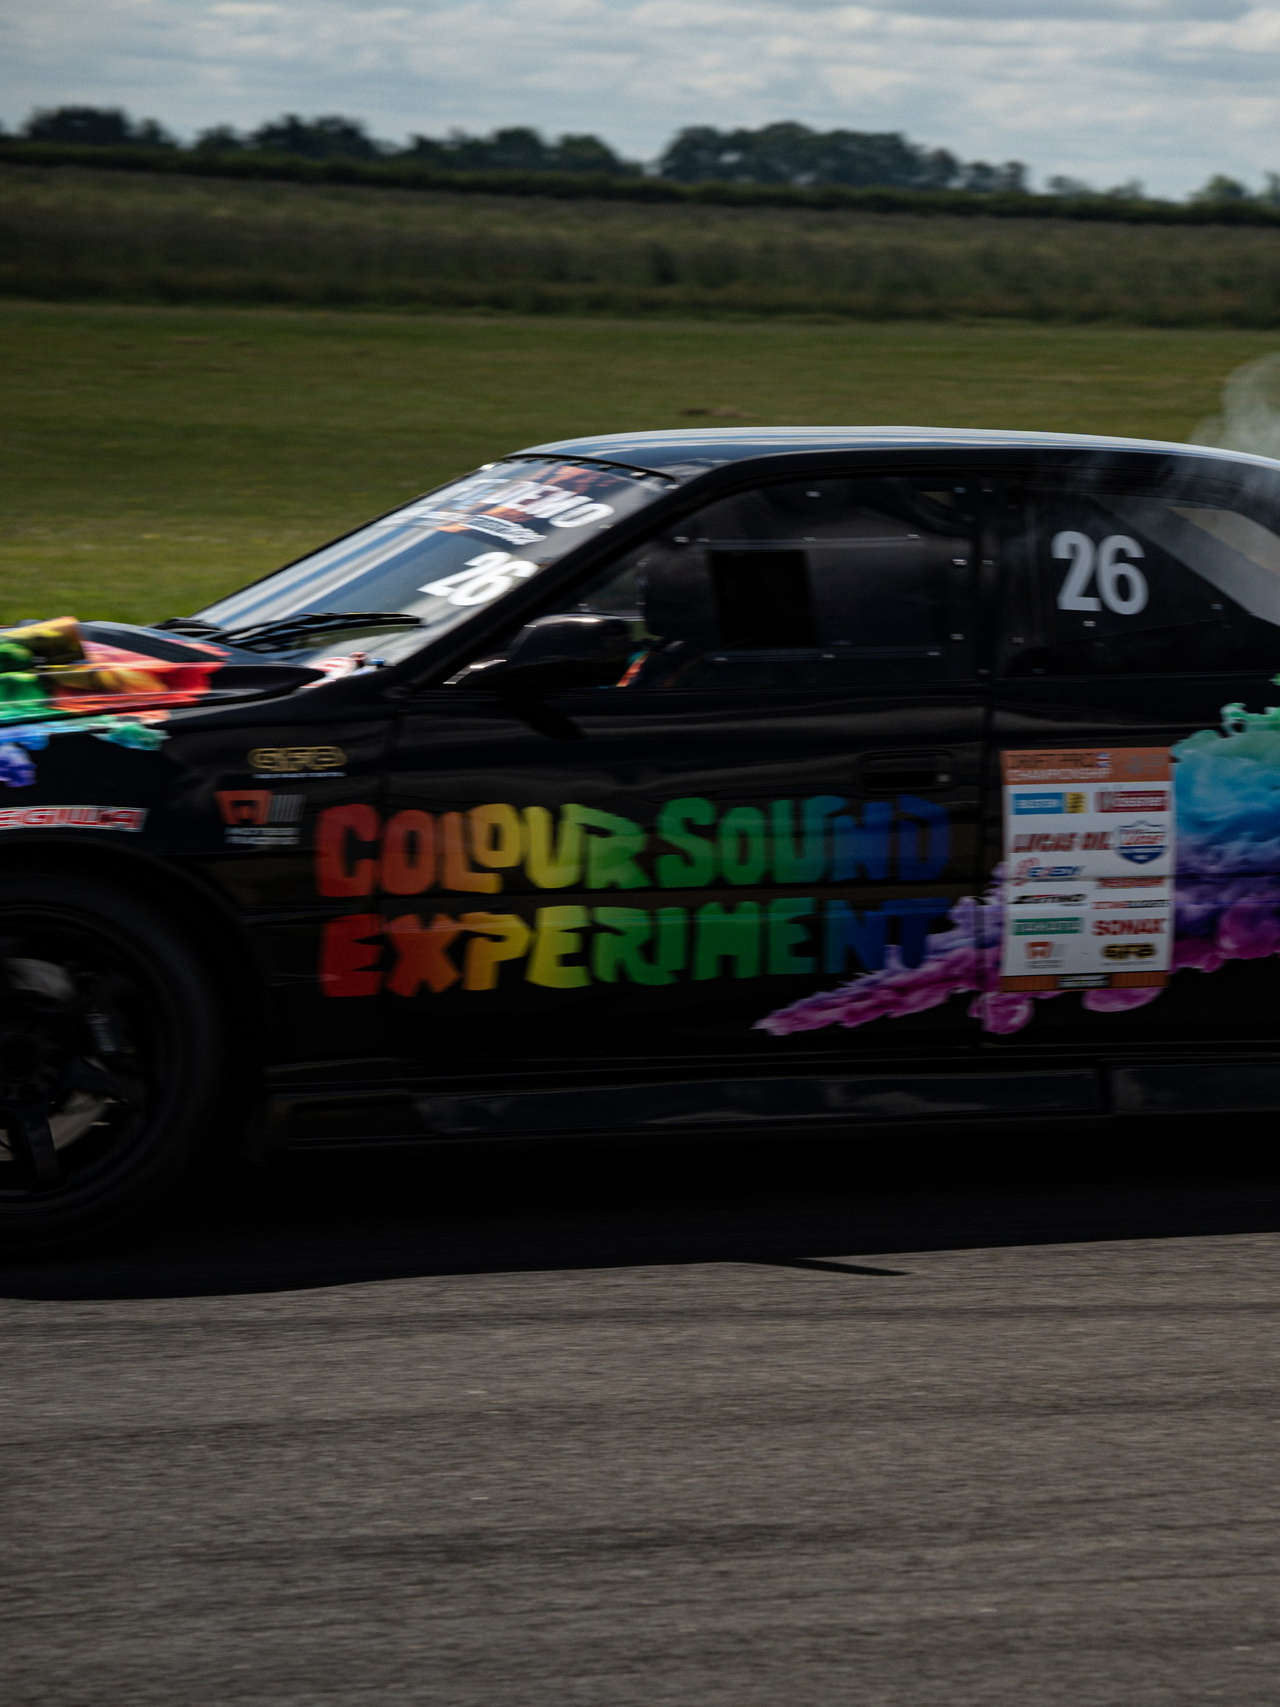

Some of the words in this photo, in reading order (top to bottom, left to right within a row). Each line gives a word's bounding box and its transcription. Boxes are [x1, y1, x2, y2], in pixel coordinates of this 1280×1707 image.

[480, 481, 615, 528] DEMO
[417, 551, 540, 607] 26
[1050, 530, 1150, 616] 26
[314, 800, 654, 898] COLOUR
[655, 795, 953, 890] SOUND
[318, 897, 951, 998] EXPERIMENT
